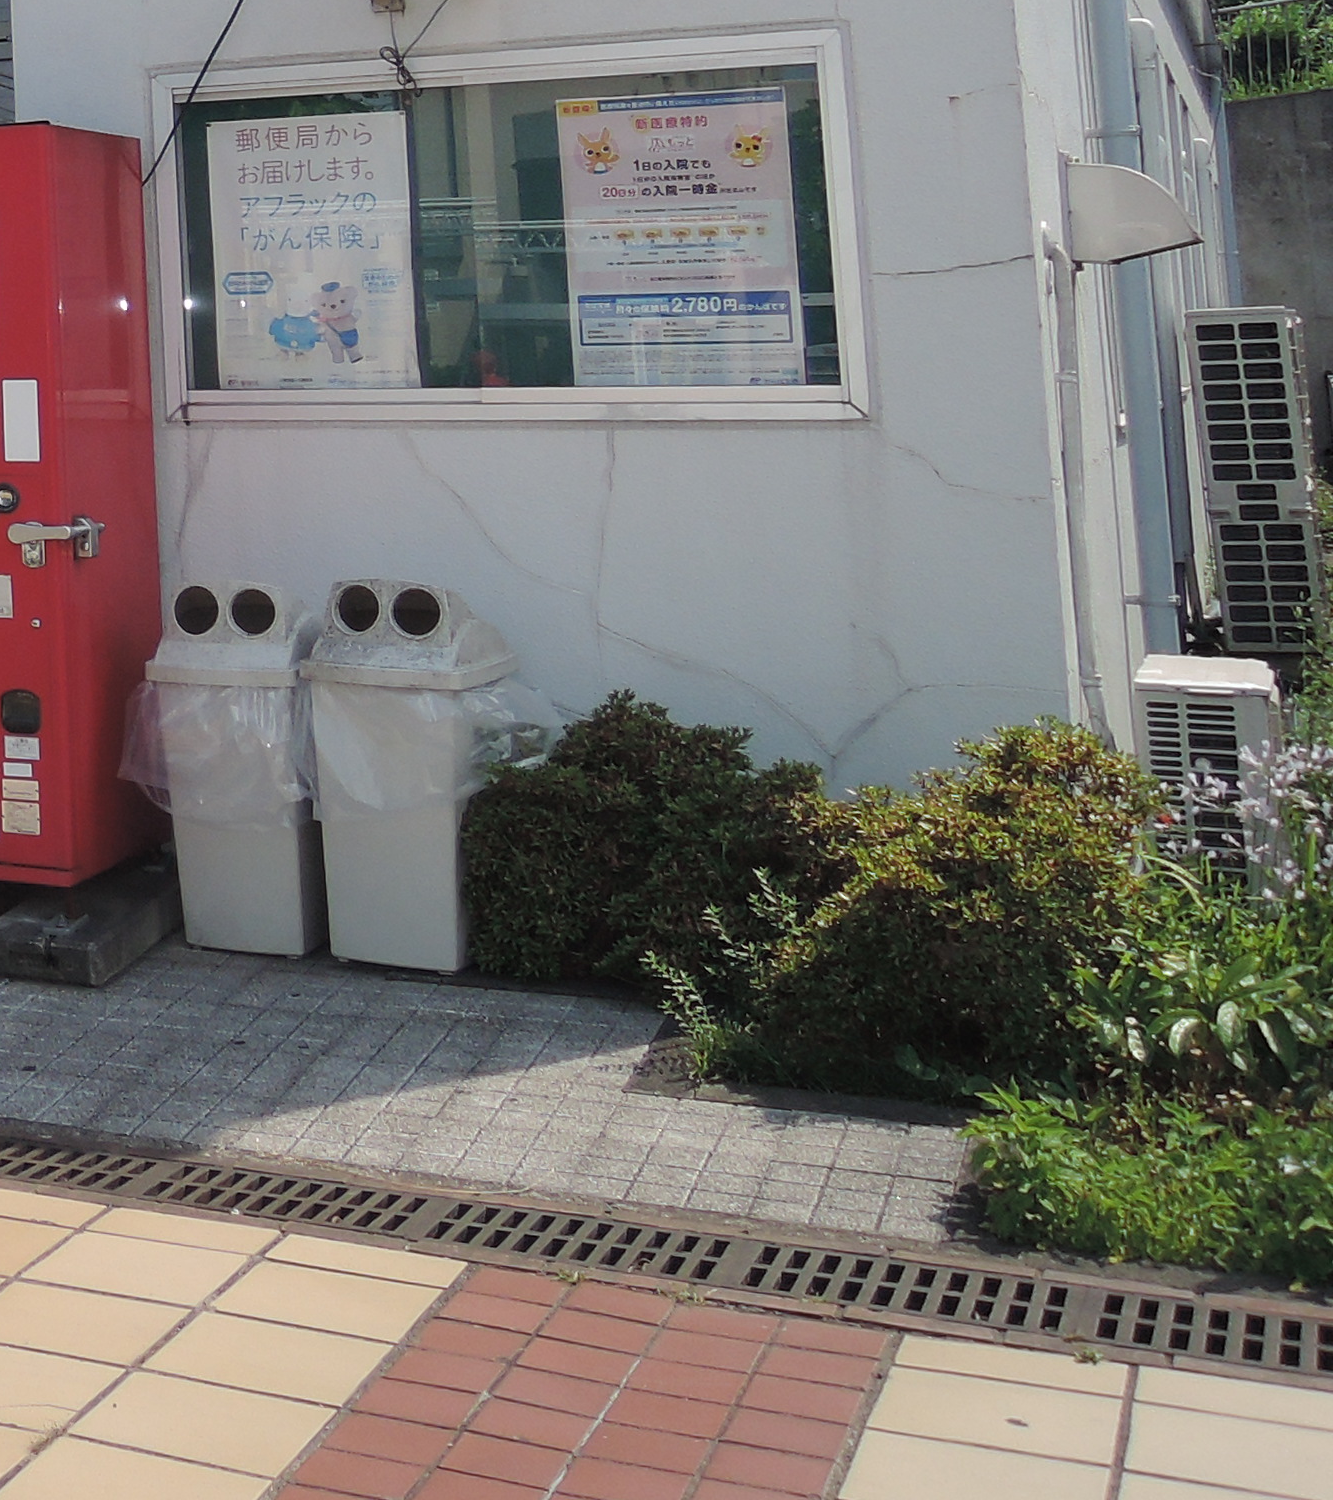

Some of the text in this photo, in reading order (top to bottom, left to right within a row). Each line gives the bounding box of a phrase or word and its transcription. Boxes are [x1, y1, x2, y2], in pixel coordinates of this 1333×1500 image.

[234, 122, 373, 152] 郵便局から
[237, 156, 374, 185] お届けします。
[239, 191, 378, 219] アフラックの
[240, 224, 382, 251] 「がん保険」
